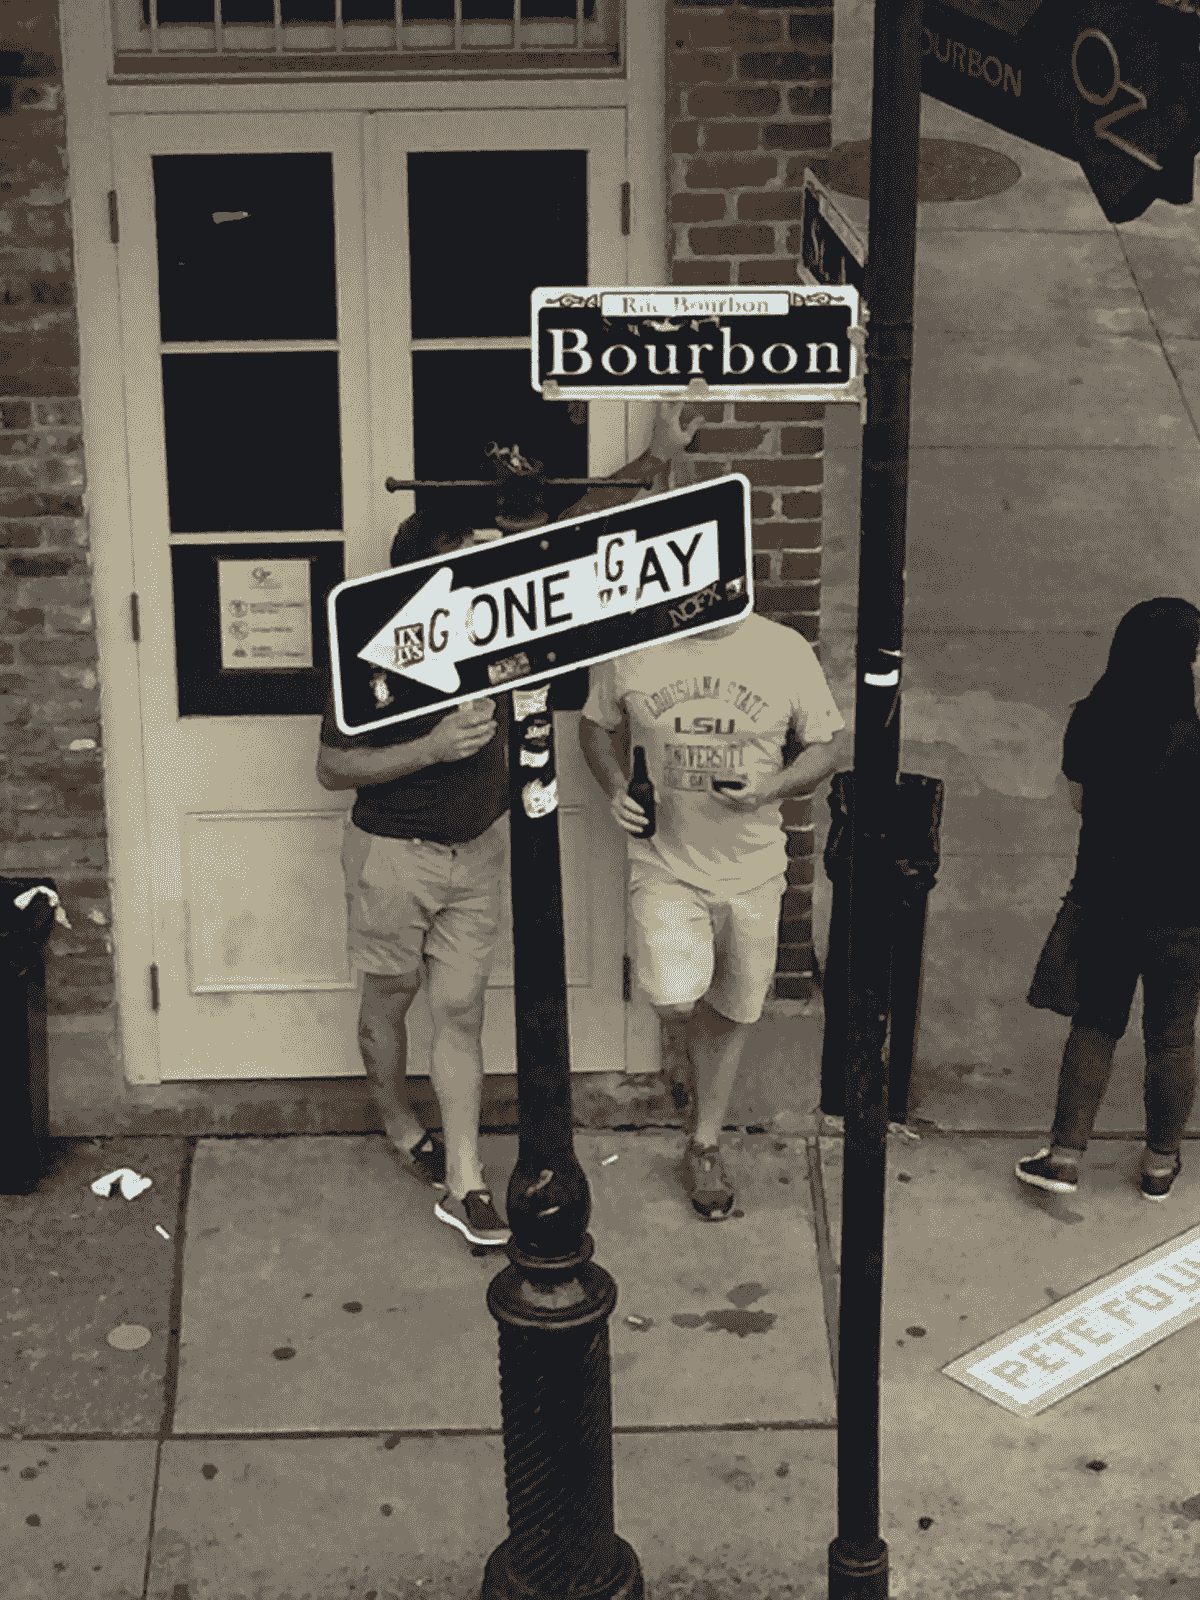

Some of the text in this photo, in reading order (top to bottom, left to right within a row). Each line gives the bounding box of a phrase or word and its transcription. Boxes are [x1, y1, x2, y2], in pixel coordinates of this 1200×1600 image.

[922, 27, 1022, 98] OURBON
[673, 296, 769, 313] Bourbon
[546, 327, 841, 376] Bourbon
[674, 717, 735, 735] LSU
[988, 1316, 1117, 1391] PETE
